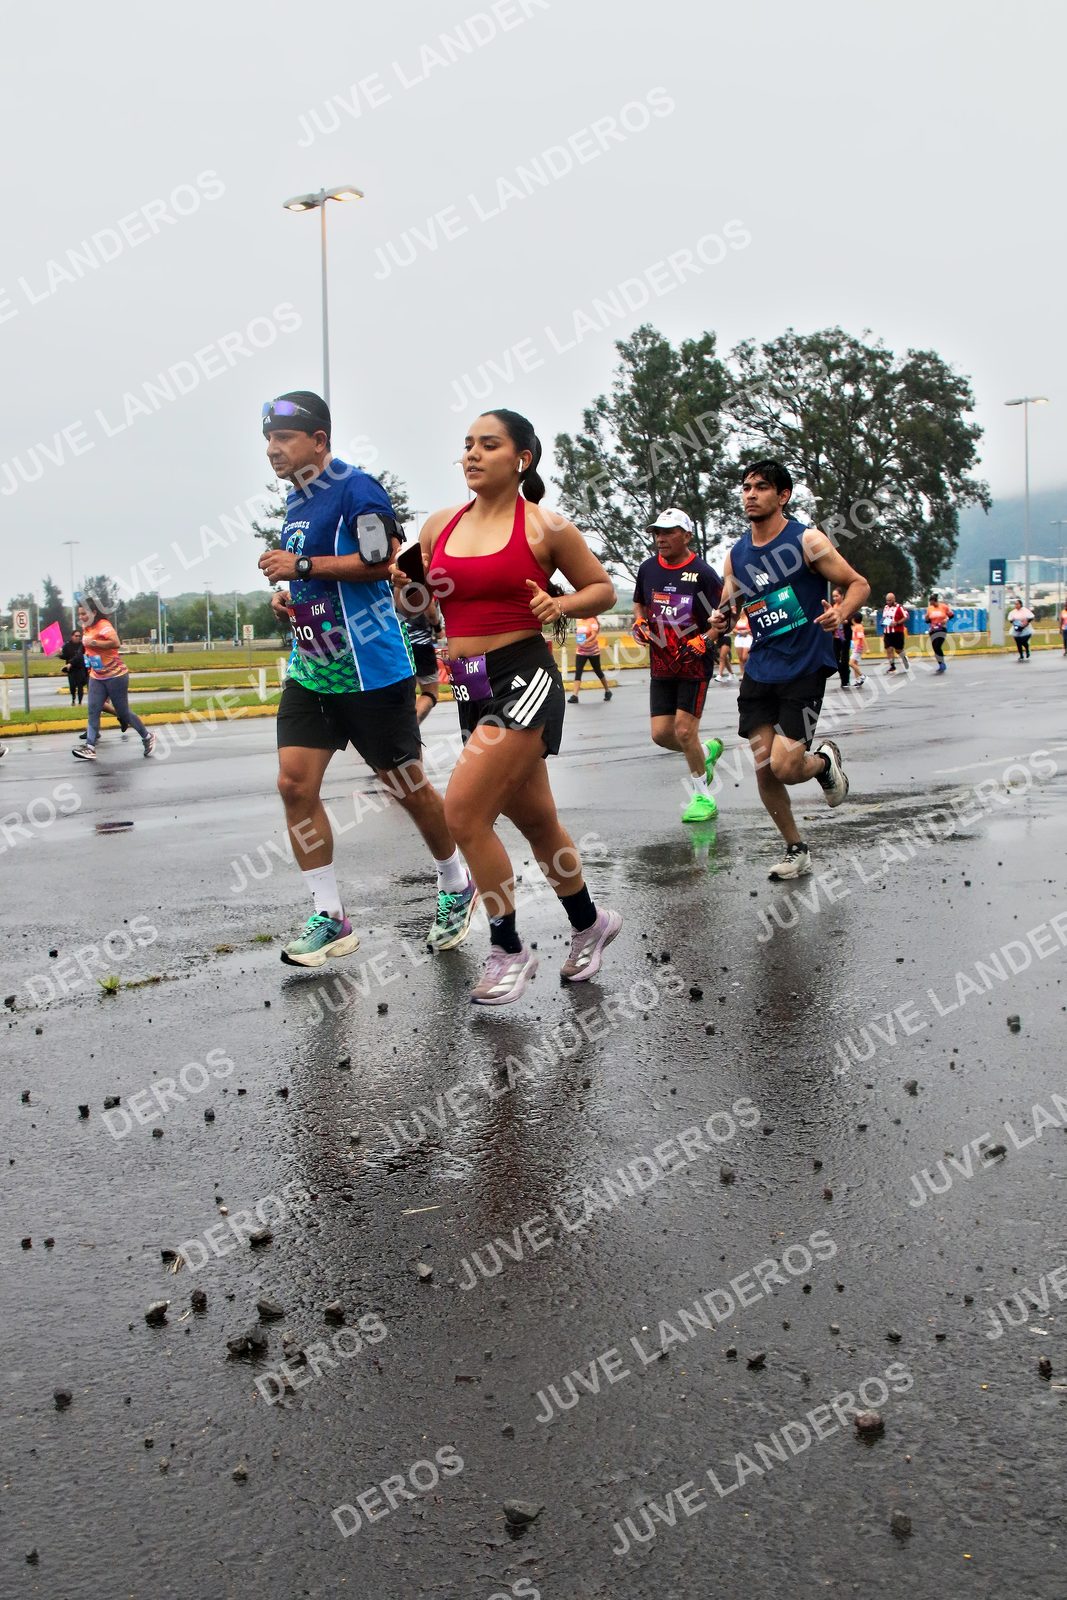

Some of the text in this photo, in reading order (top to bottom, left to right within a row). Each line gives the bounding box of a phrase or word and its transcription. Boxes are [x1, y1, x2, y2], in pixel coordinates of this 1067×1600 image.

[680, 571, 698, 583] 21K
[992, 570, 1002, 582] E
[310, 602, 326, 617] 15K
[660, 605, 678, 616] 761
[756, 608, 788, 629] 1394
[464, 660, 479, 675] 15K
